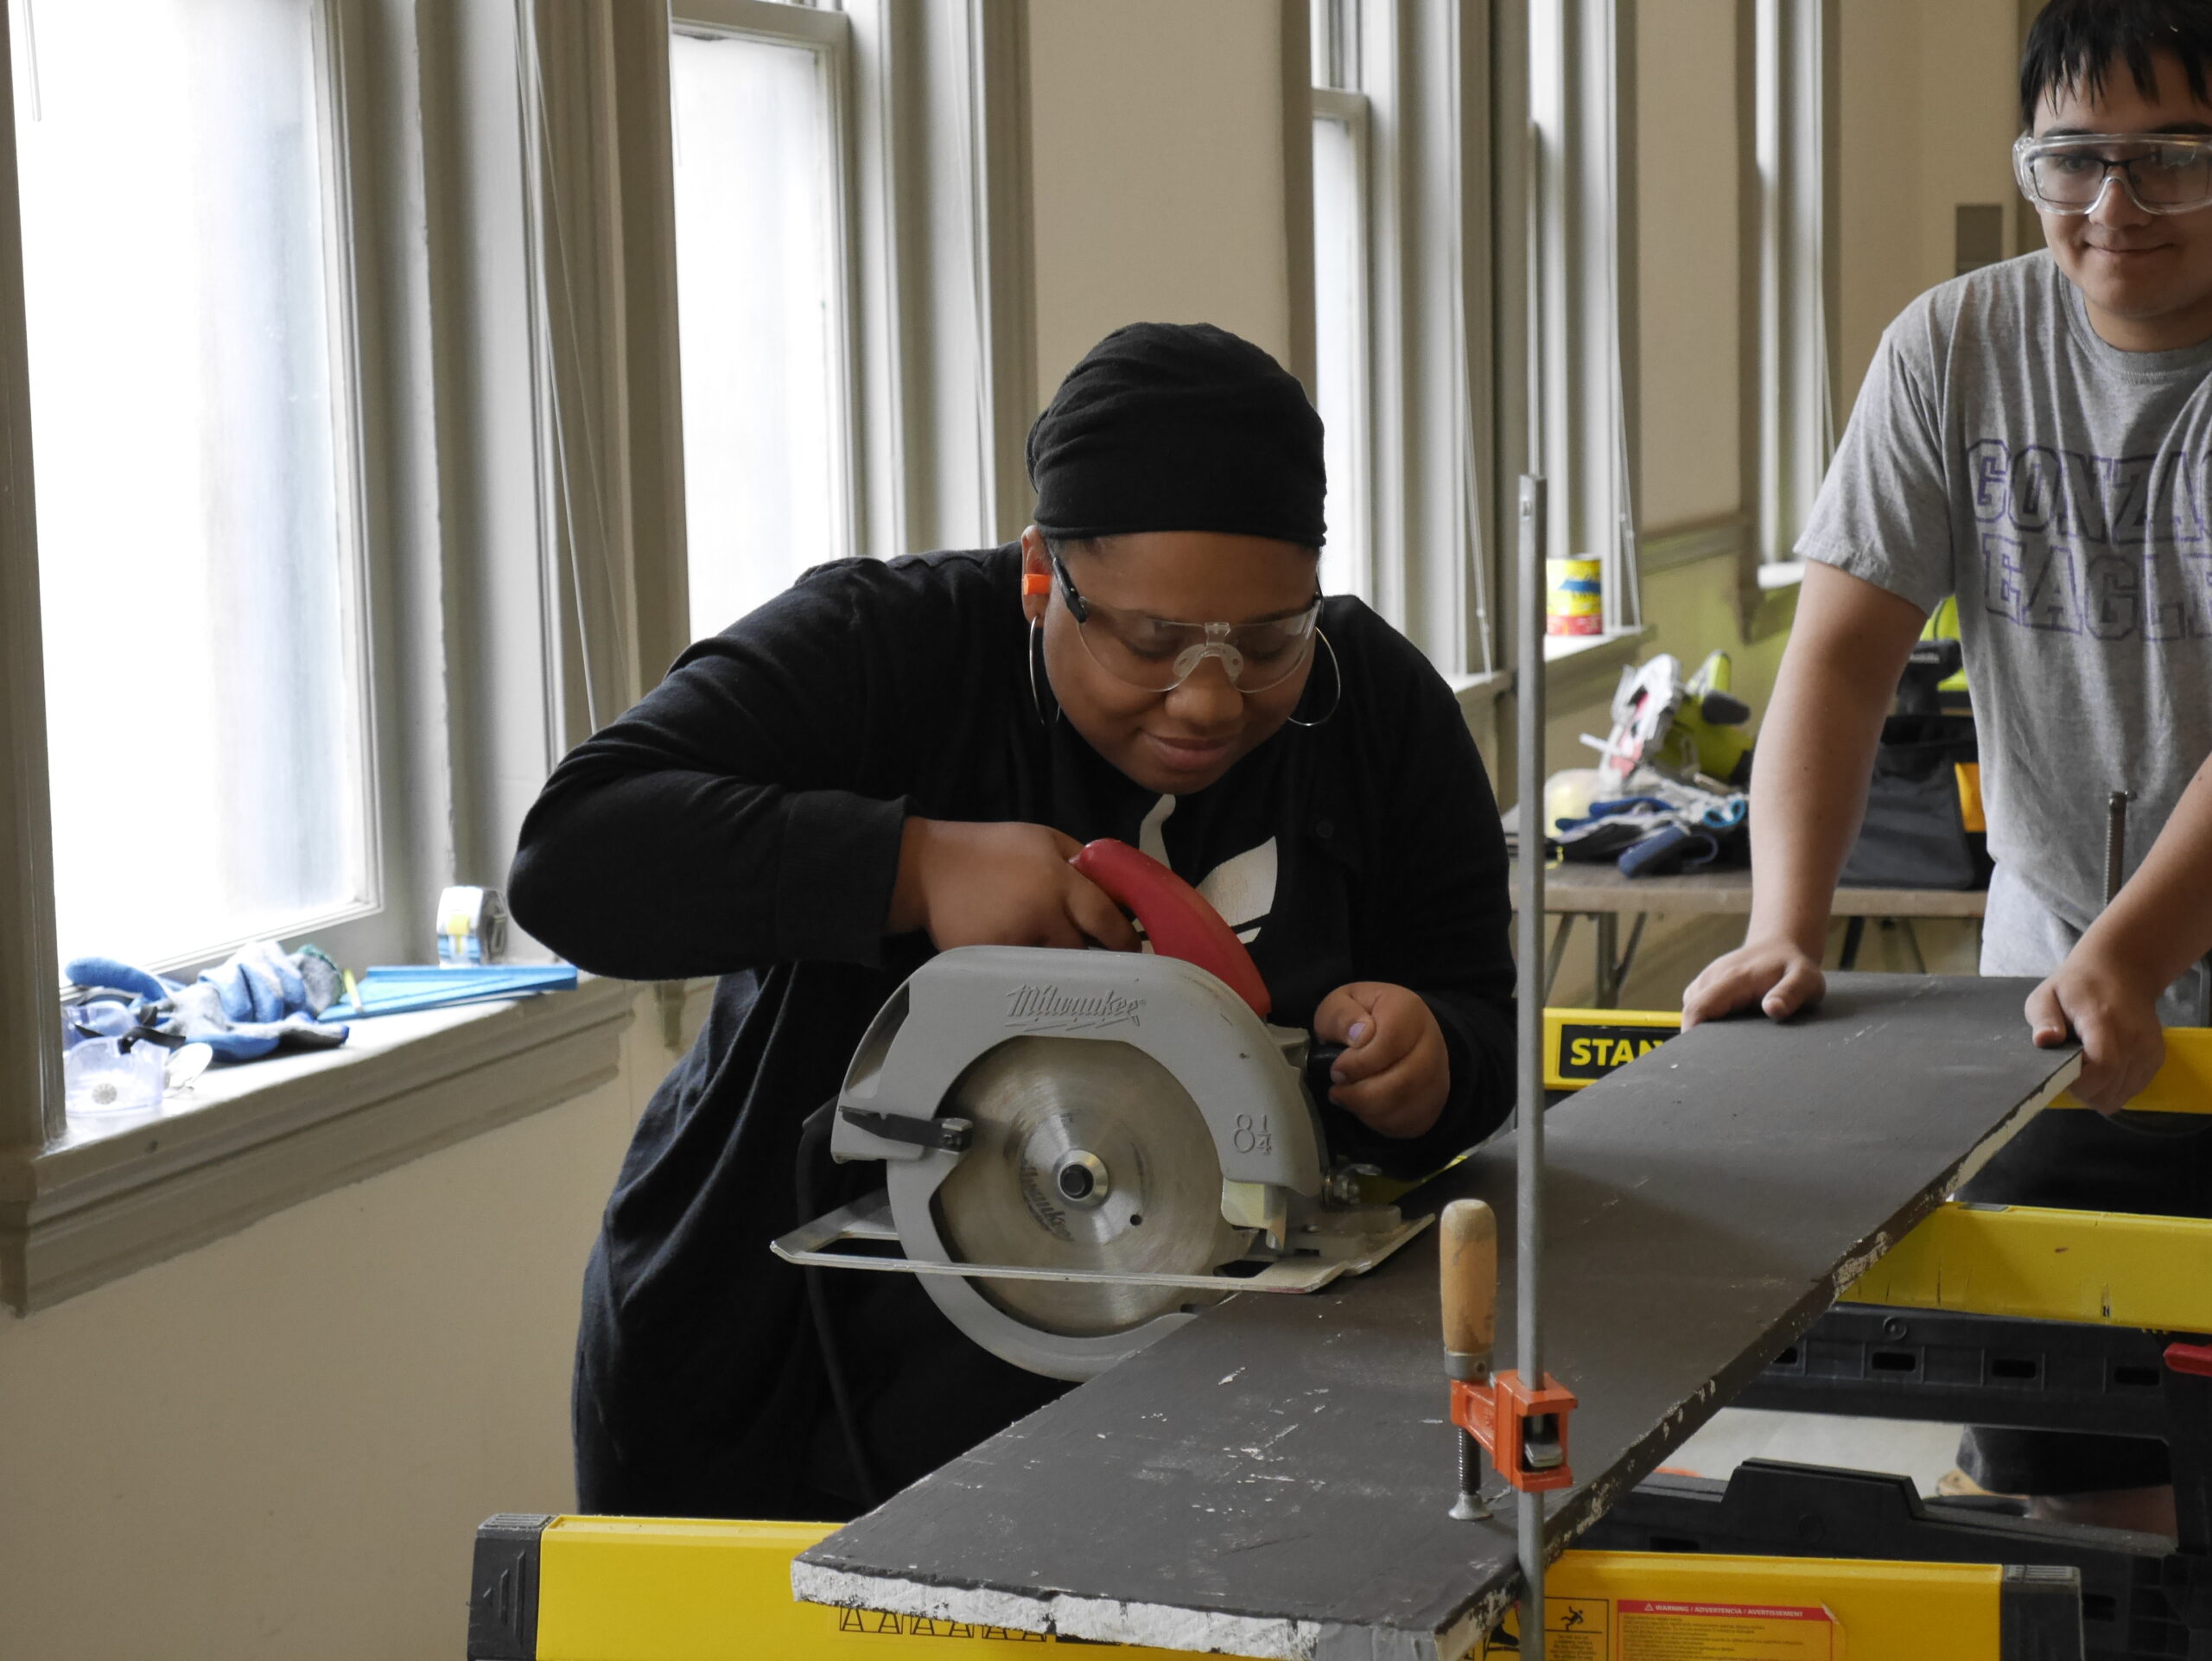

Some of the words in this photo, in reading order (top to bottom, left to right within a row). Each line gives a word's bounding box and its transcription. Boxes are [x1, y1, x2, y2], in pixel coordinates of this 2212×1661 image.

[1967, 438, 2212, 544] GONZA
[1006, 983, 1141, 1027] Milwaukee
[1655, 1604, 1690, 1613] WARNING
[1694, 1606, 1743, 1615] ADVERTENCIA
[1747, 1608, 1804, 1618] AVERTISSEMENT
